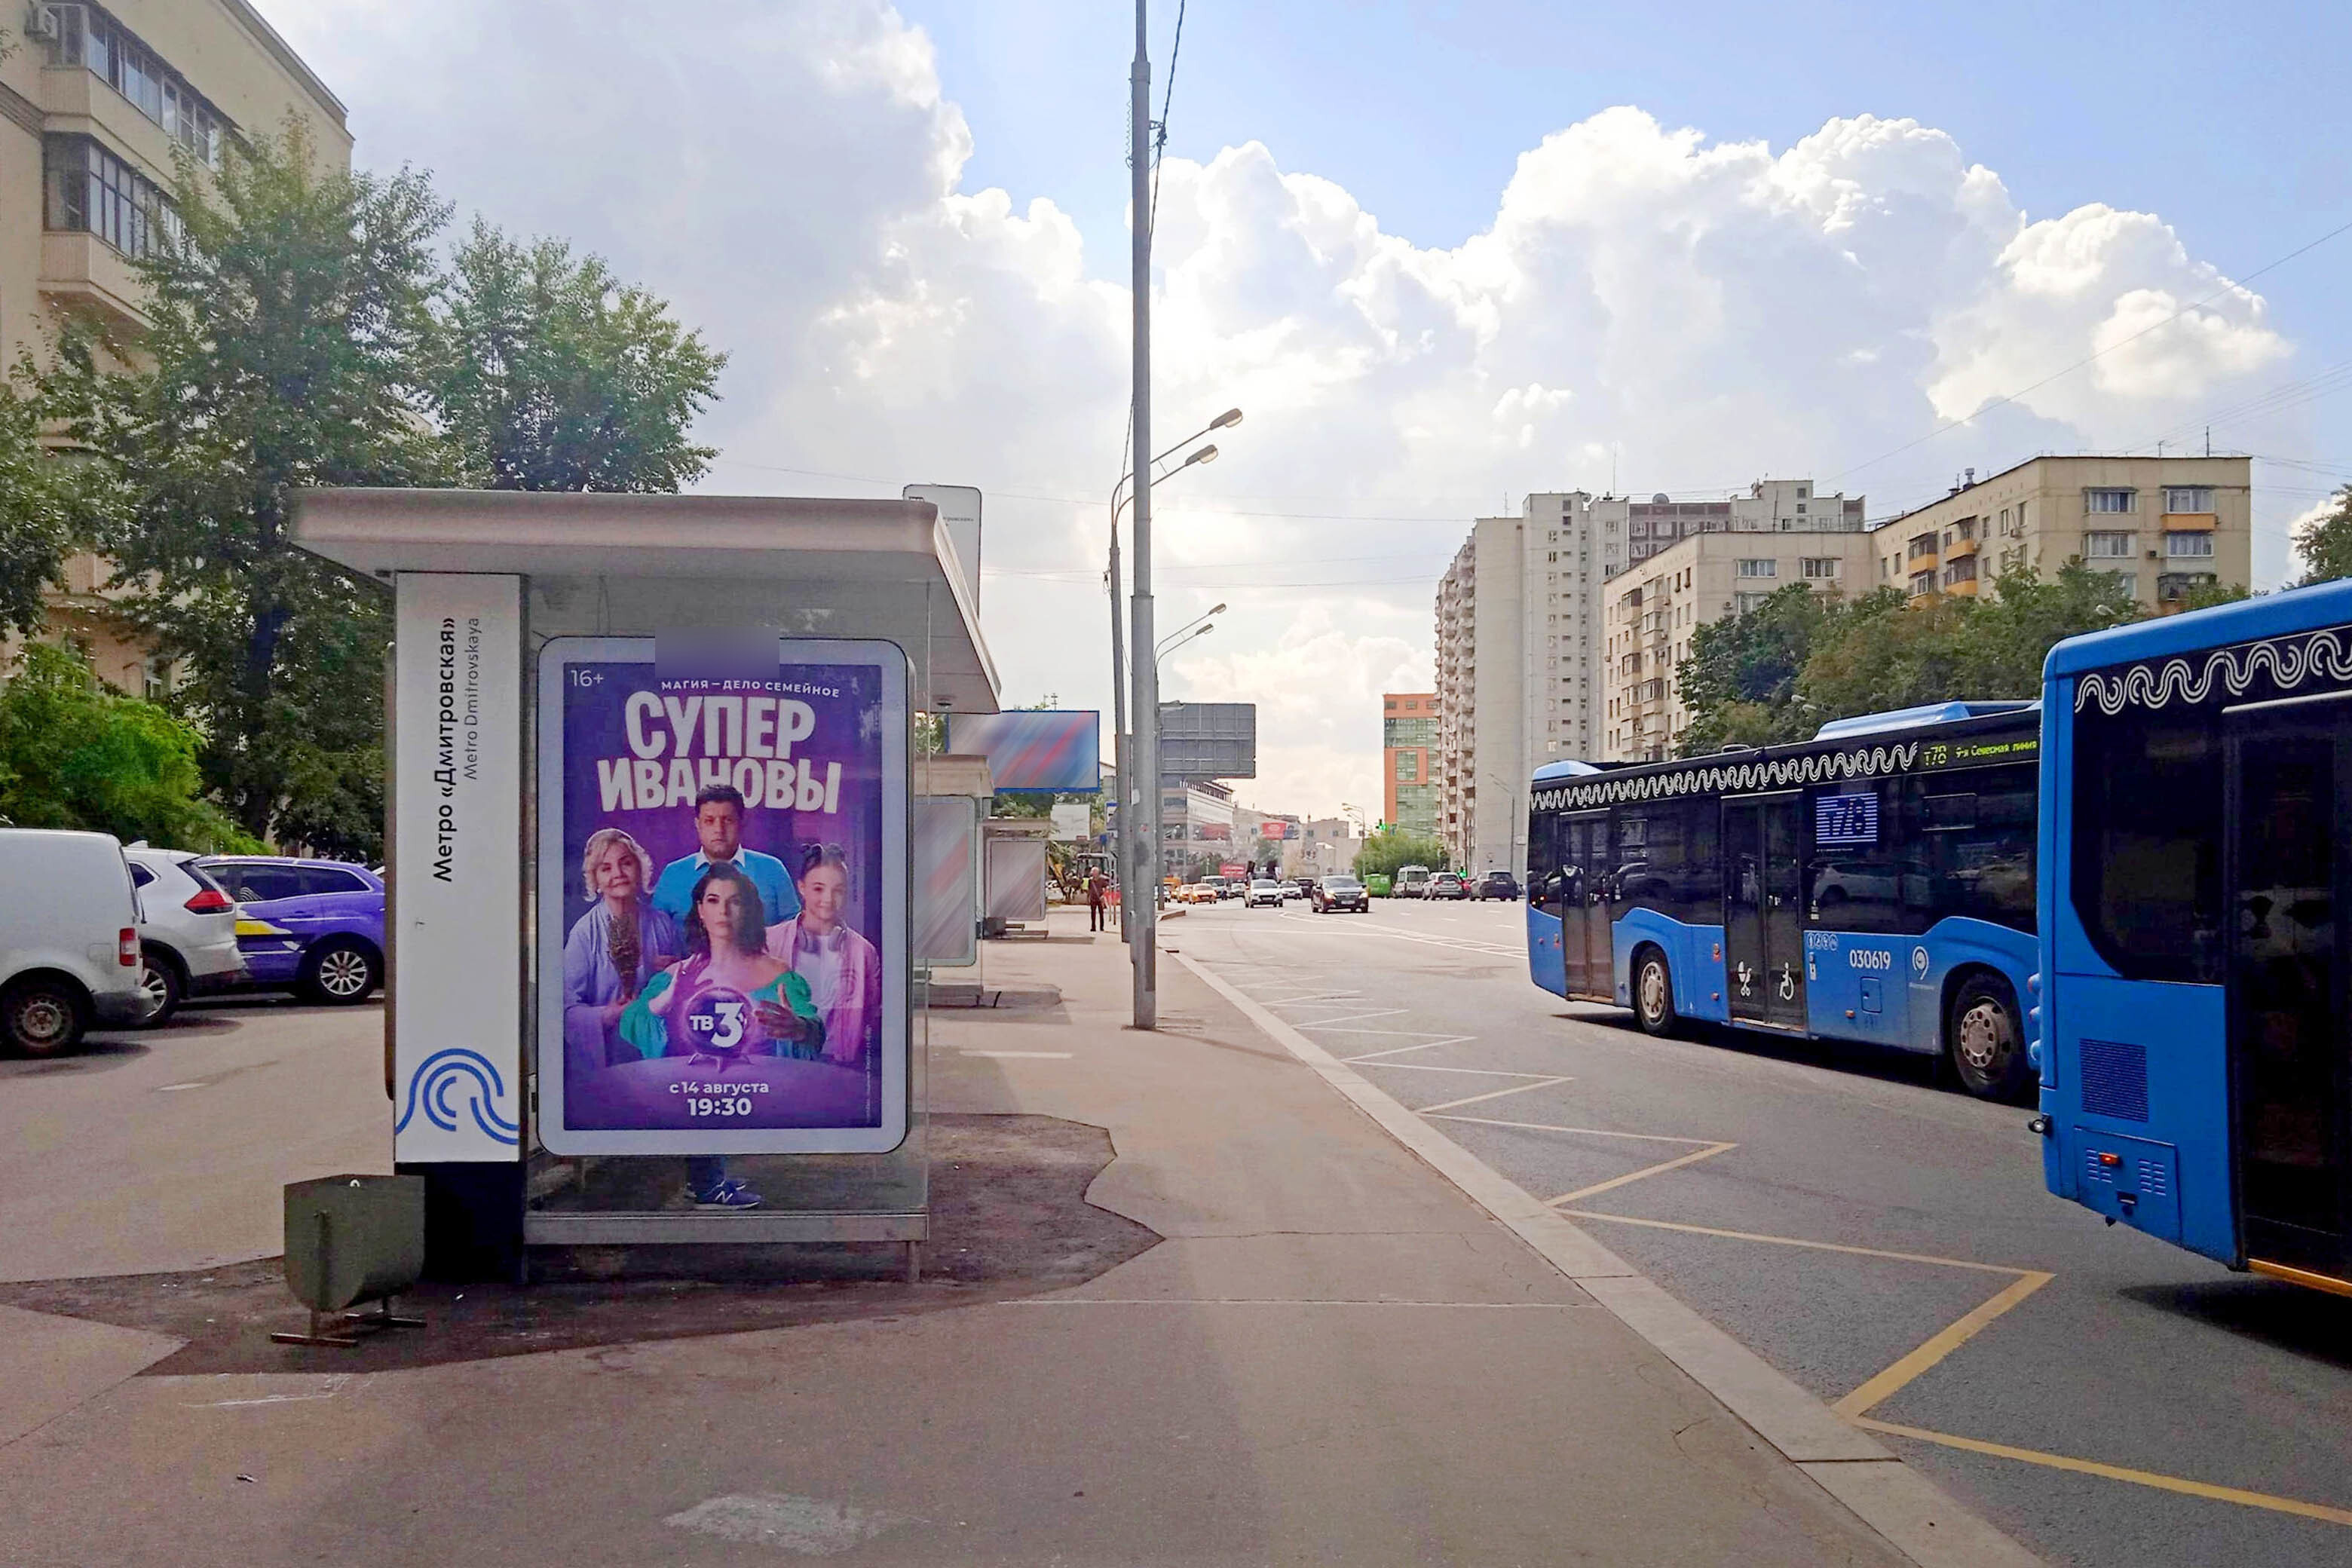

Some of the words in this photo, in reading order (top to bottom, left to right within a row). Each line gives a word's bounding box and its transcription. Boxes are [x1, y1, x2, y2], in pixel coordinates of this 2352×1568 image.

[464, 617, 482, 726] Dmitrovskaya
[571, 669, 604, 688] 16+
[661, 680, 709, 691] МАГИЯ
[723, 680, 761, 691] ДЕЛО
[764, 681, 840, 698] СЕМЕЙНОЕ
[433, 617, 459, 798] «Дмитровская»
[624, 690, 816, 760] СУПЕР
[464, 730, 478, 780] Metro
[596, 757, 842, 815] ИВАНОВЫ
[433, 805, 458, 883] Метро
[1849, 949, 1891, 970] 030619
[681, 1081, 700, 1093] 14
[703, 1083, 769, 1096] августа
[687, 1098, 752, 1116] 19:30
